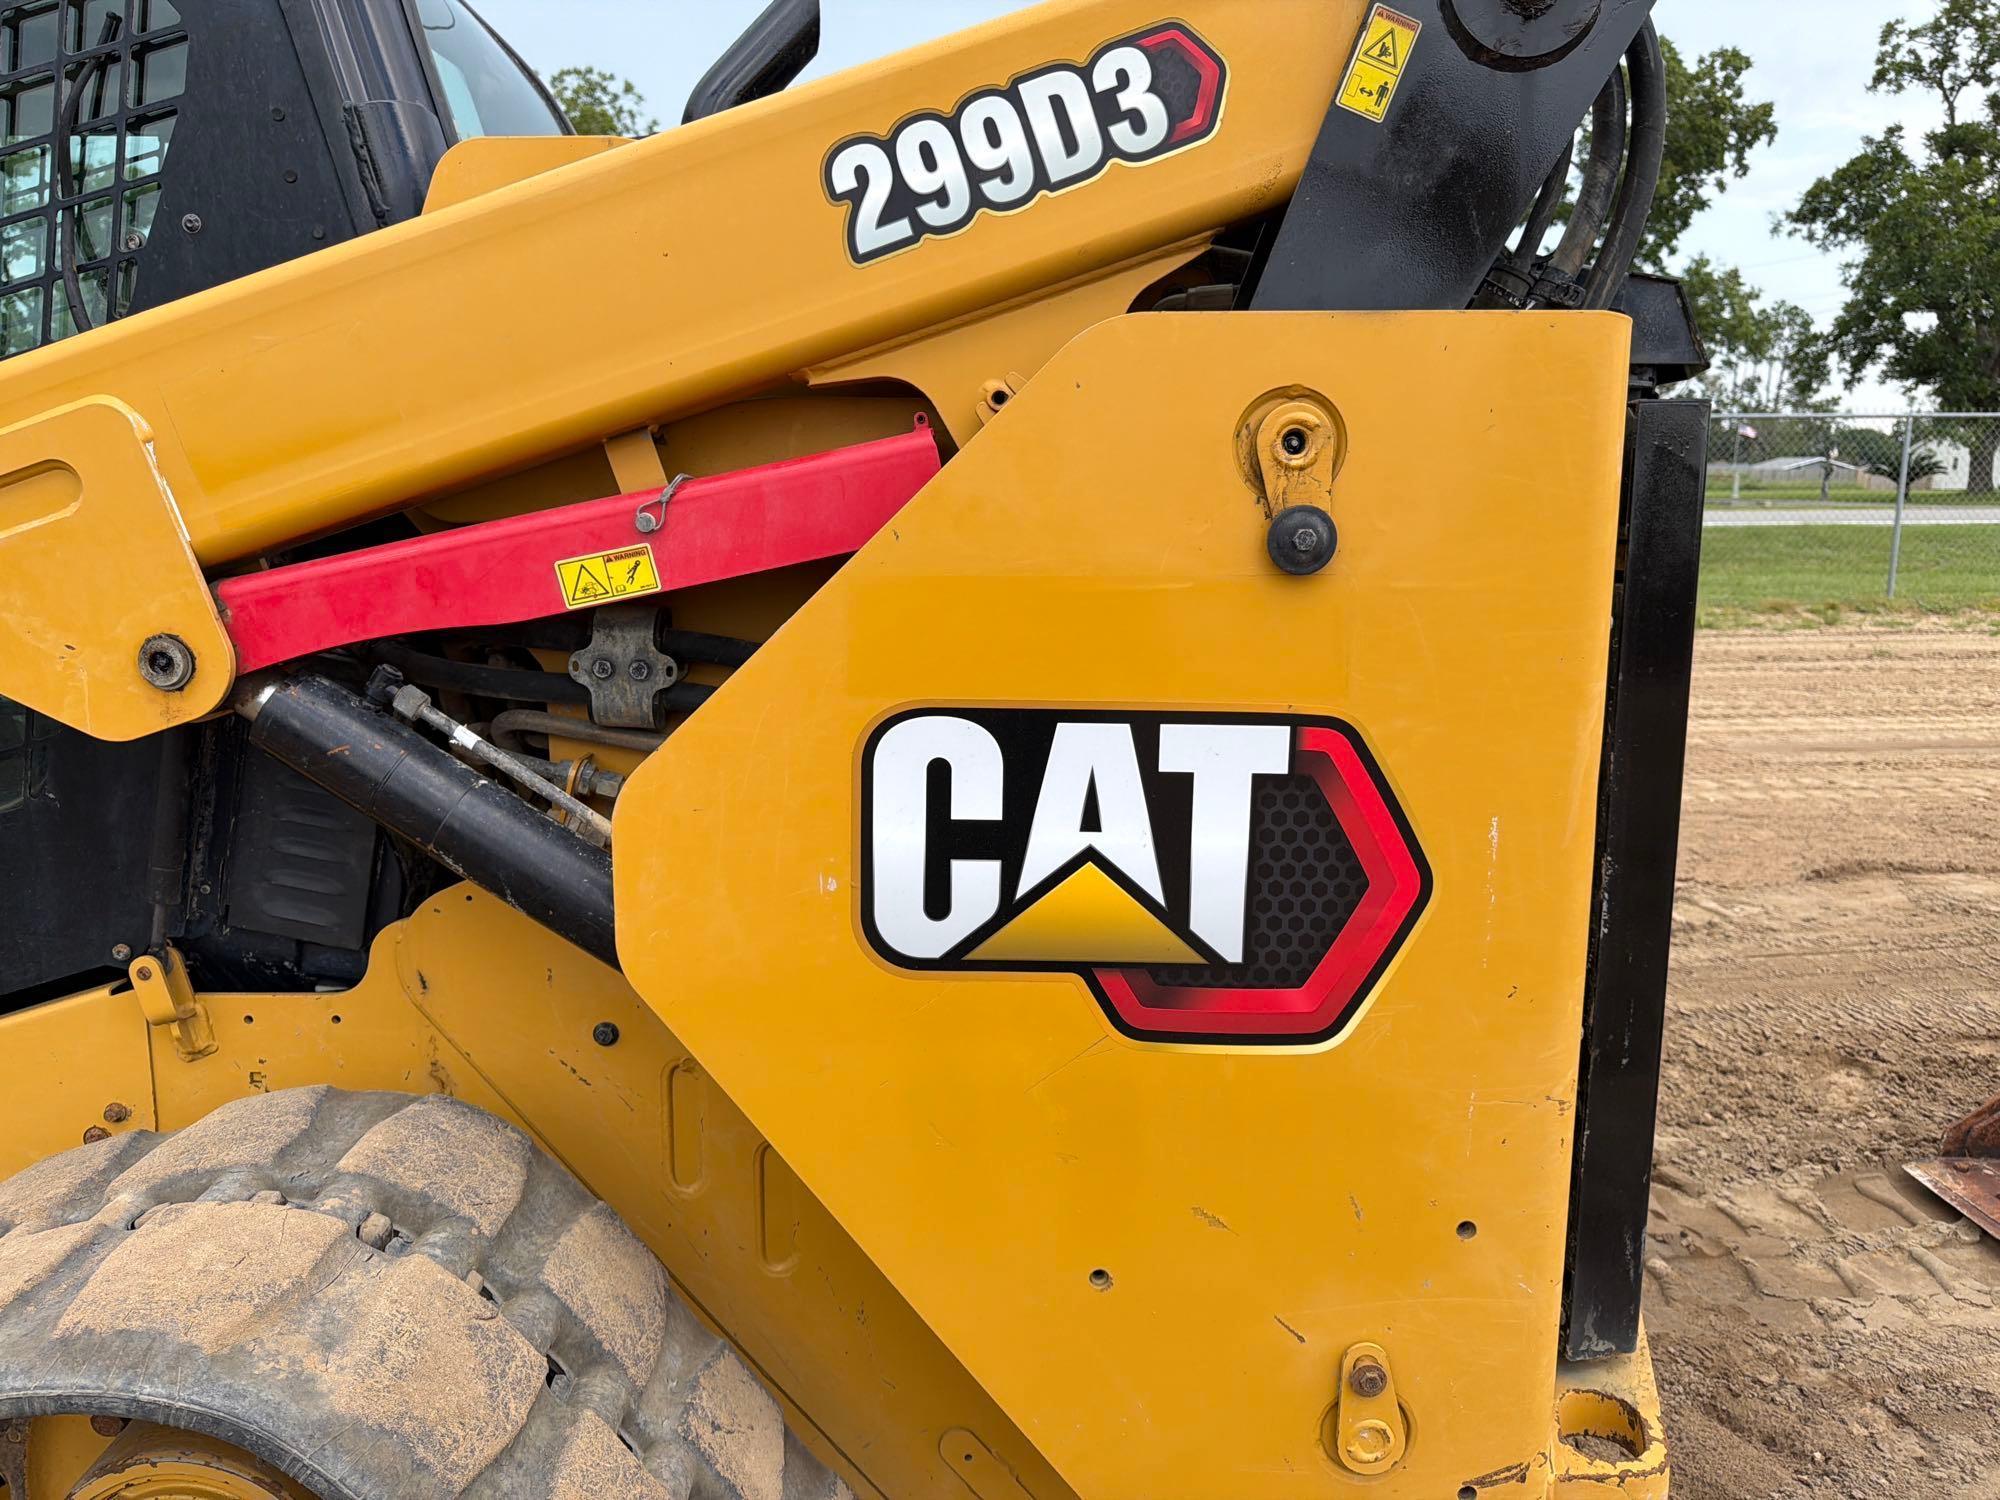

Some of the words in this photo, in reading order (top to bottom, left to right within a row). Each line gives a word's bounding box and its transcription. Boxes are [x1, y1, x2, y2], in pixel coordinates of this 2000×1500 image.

[1385, 13, 1417, 31] WARNING
[831, 46, 1169, 255] 299D3
[613, 549, 647, 561] WARNING
[873, 715, 1291, 964] CAT
